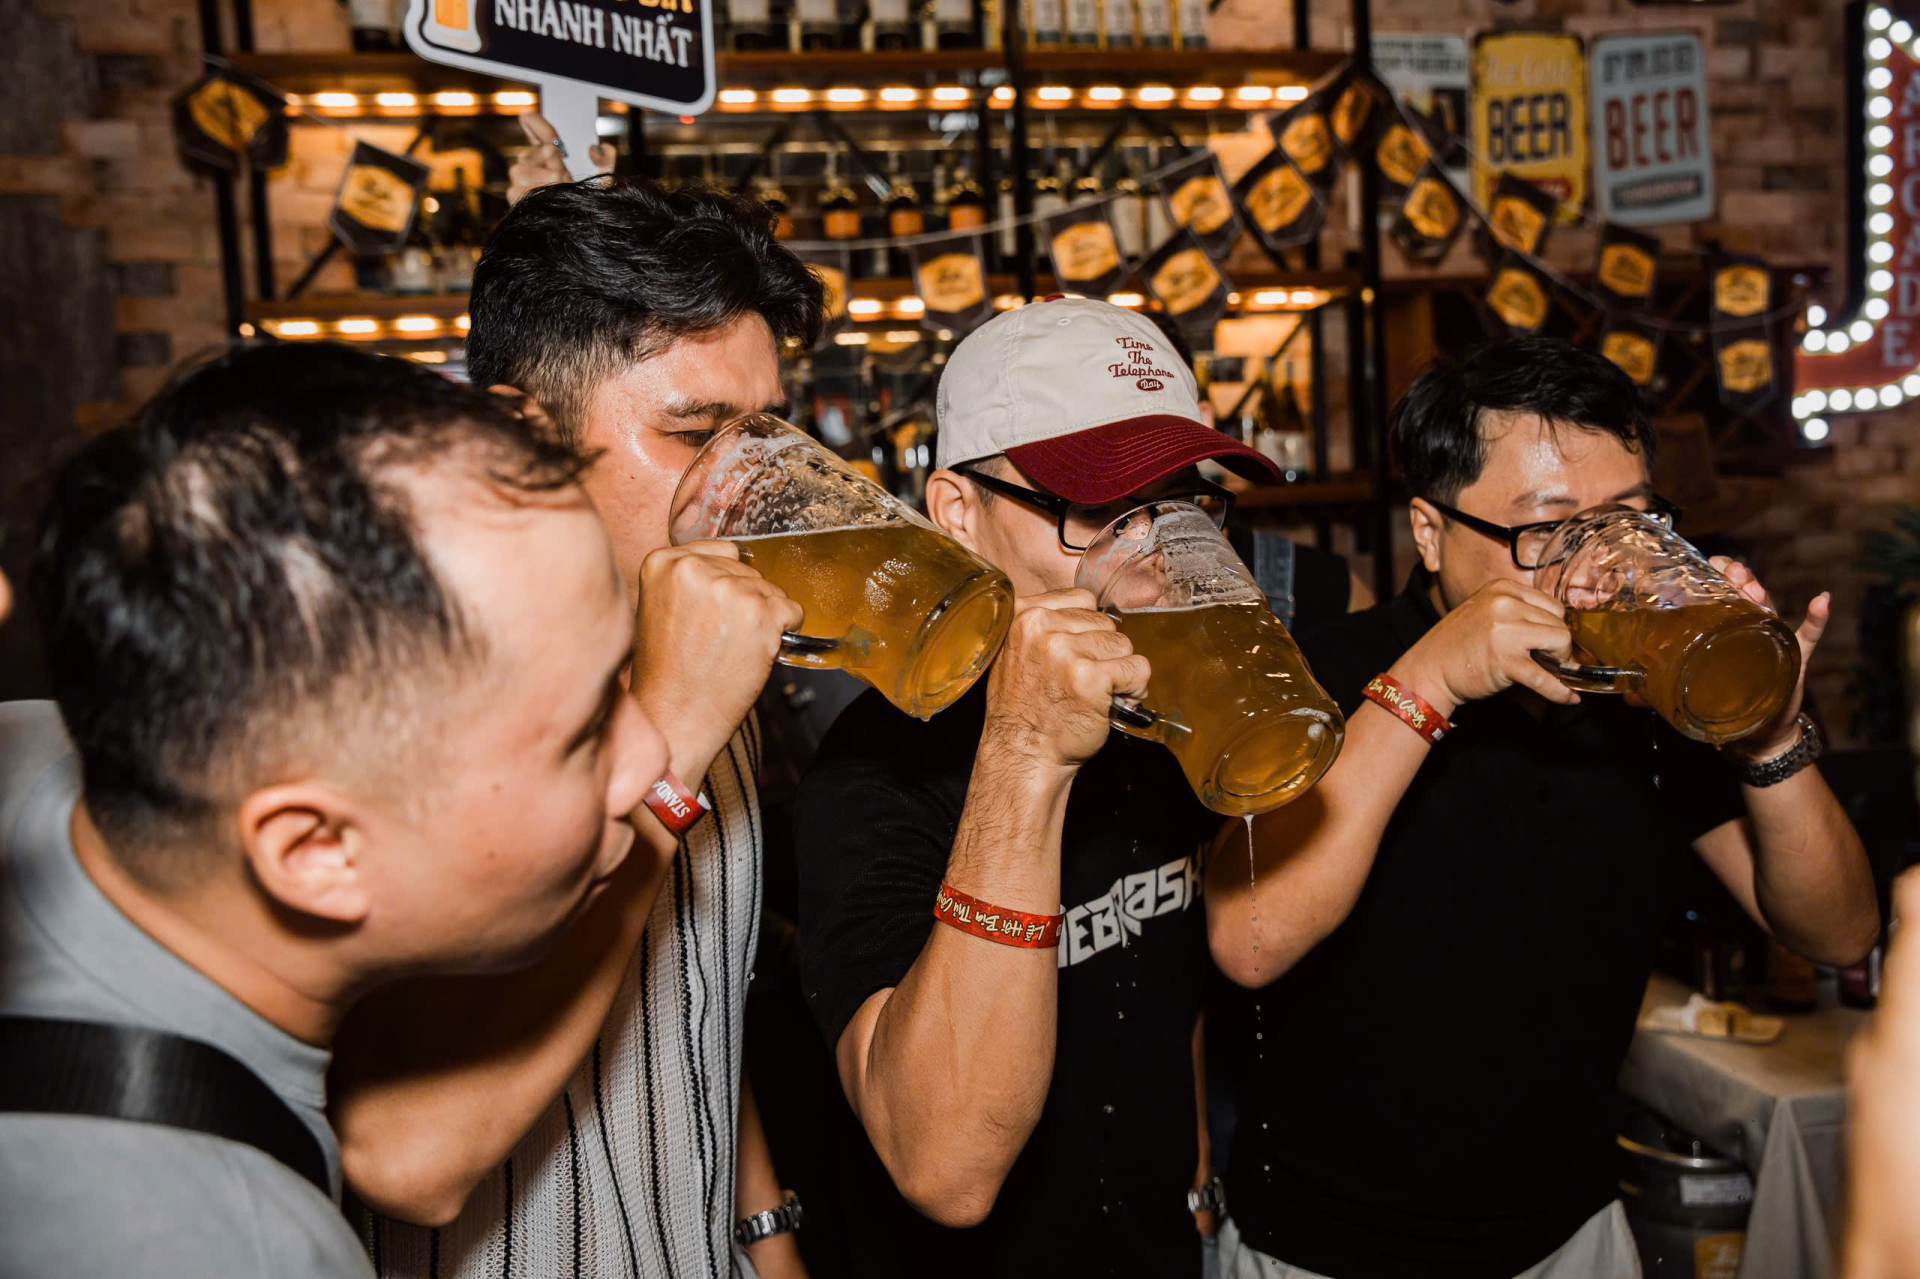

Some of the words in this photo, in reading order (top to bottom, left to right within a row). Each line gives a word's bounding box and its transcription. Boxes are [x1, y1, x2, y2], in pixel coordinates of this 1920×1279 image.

[494, 0, 605, 49] NHANH
[611, 12, 692, 68] NHẤT
[1488, 93, 1572, 166] BEER
[1605, 87, 1699, 172] BEER
[1115, 336, 1154, 351] Time
[1127, 350, 1153, 365] The
[1108, 362, 1175, 378] Telephone
